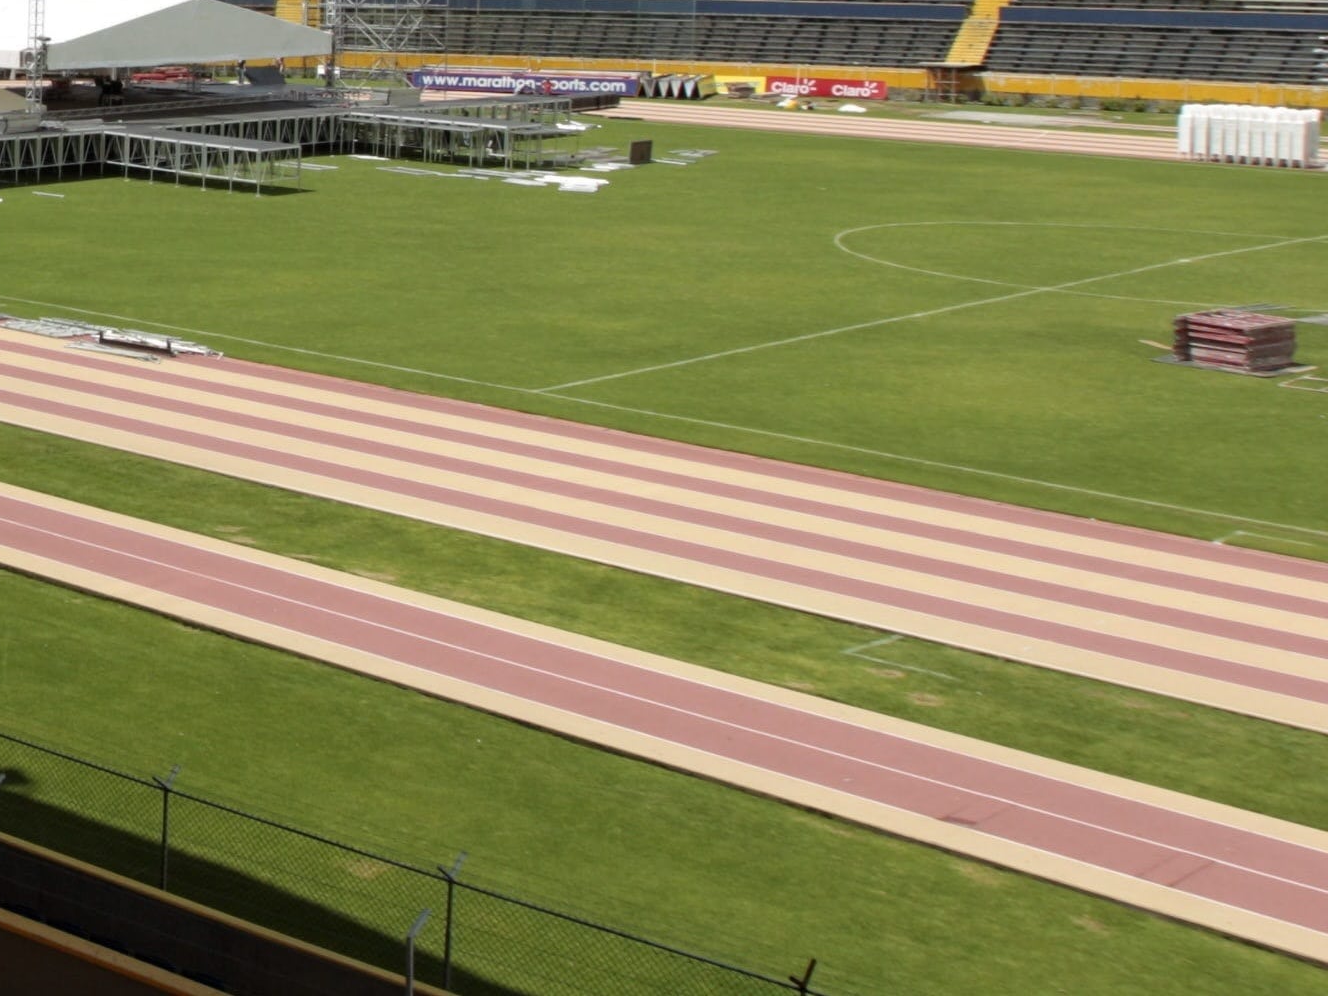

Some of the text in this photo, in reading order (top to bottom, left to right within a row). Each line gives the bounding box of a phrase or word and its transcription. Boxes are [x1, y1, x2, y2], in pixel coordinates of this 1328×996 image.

[422, 75, 627, 93] www.marathon-ports.com
[771, 81, 810, 94] Claro
[831, 84, 870, 96] Claro
